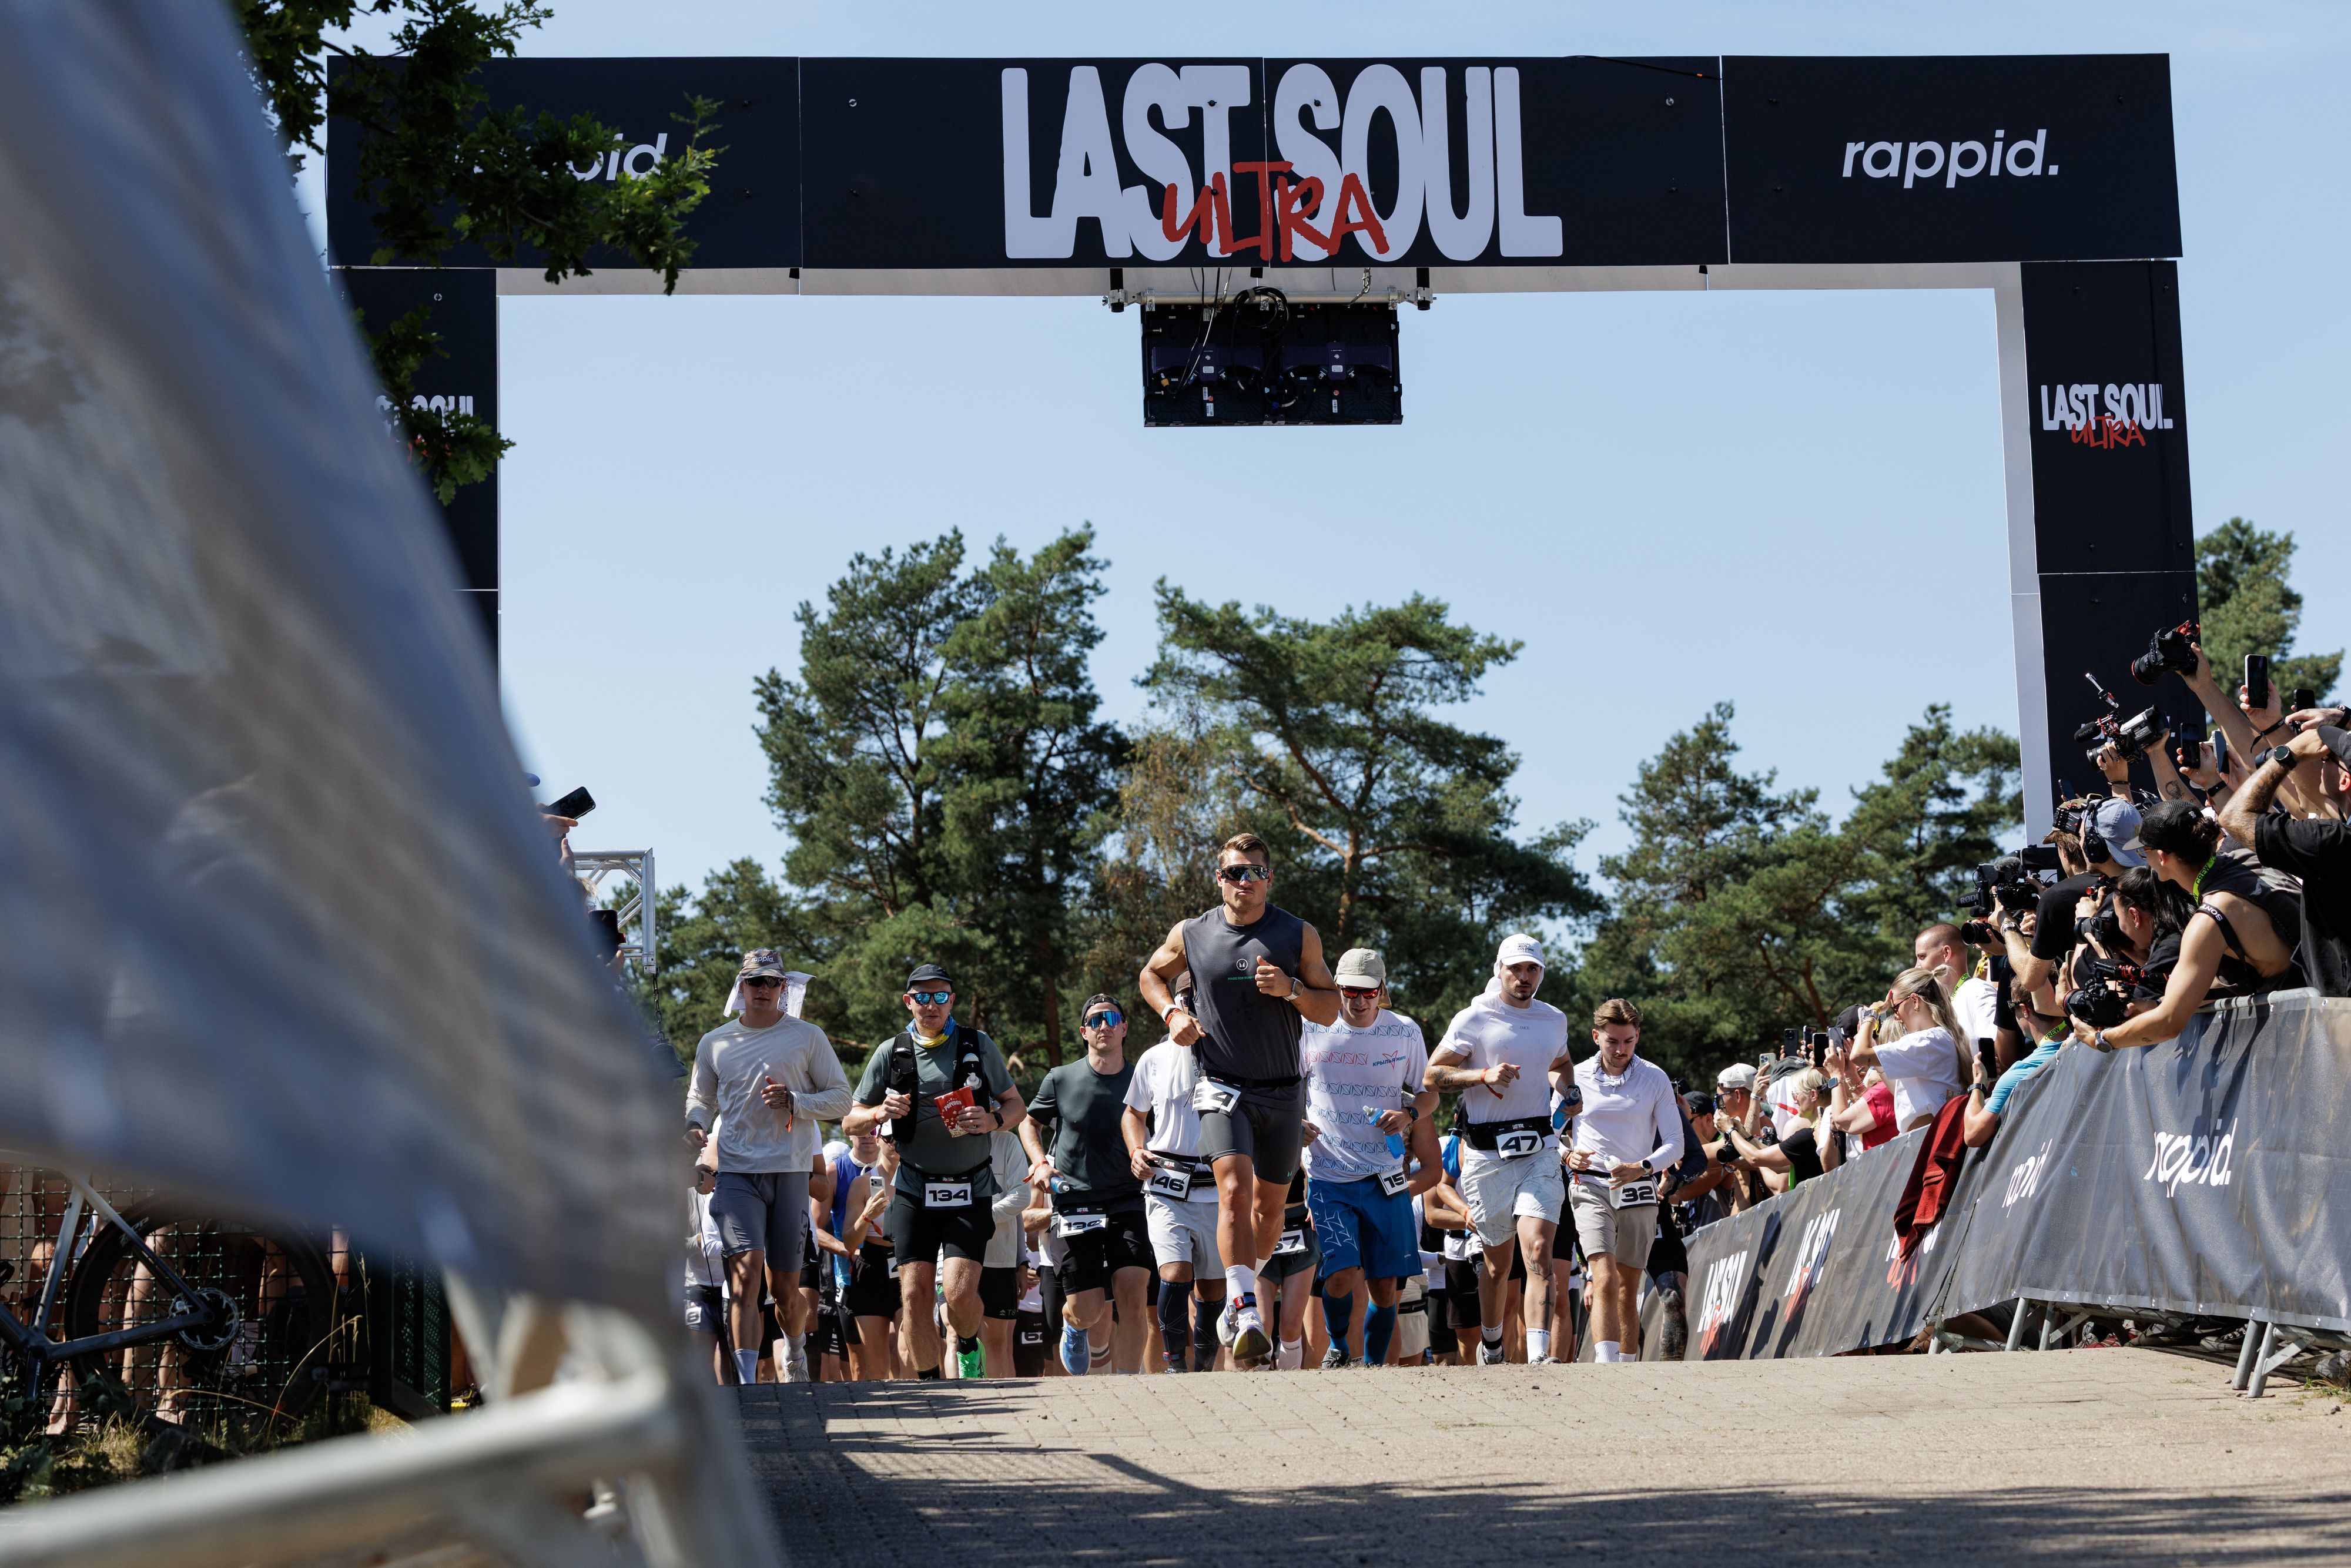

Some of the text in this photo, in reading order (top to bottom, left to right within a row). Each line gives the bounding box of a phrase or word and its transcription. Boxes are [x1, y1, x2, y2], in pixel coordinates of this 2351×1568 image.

[1001, 62, 1563, 262] LAST SOUL
[1841, 129, 2059, 189] rappid.
[1161, 160, 1390, 262] ULTRA
[2041, 383, 2173, 431] LAST SOUL
[2071, 416, 2146, 450] ULTRA
[2195, 865, 2211, 885] CREW
[2199, 904, 2223, 921] SONY
[2045, 1026, 2060, 1040] CREW
[1372, 1058, 1395, 1067] КРЫЛЬЯ
[944, 1100, 962, 1111] POPCORN
[1501, 1135, 1538, 1152] 47
[2143, 1117, 2238, 1198] rappid.
[1150, 1174, 1185, 1192] 146
[1383, 1172, 1406, 1188] 15
[929, 1189, 969, 1202] 134
[1620, 1185, 1655, 1203] 32
[1063, 1219, 1103, 1231] 130
[1024, 1331, 1043, 1342] 6
